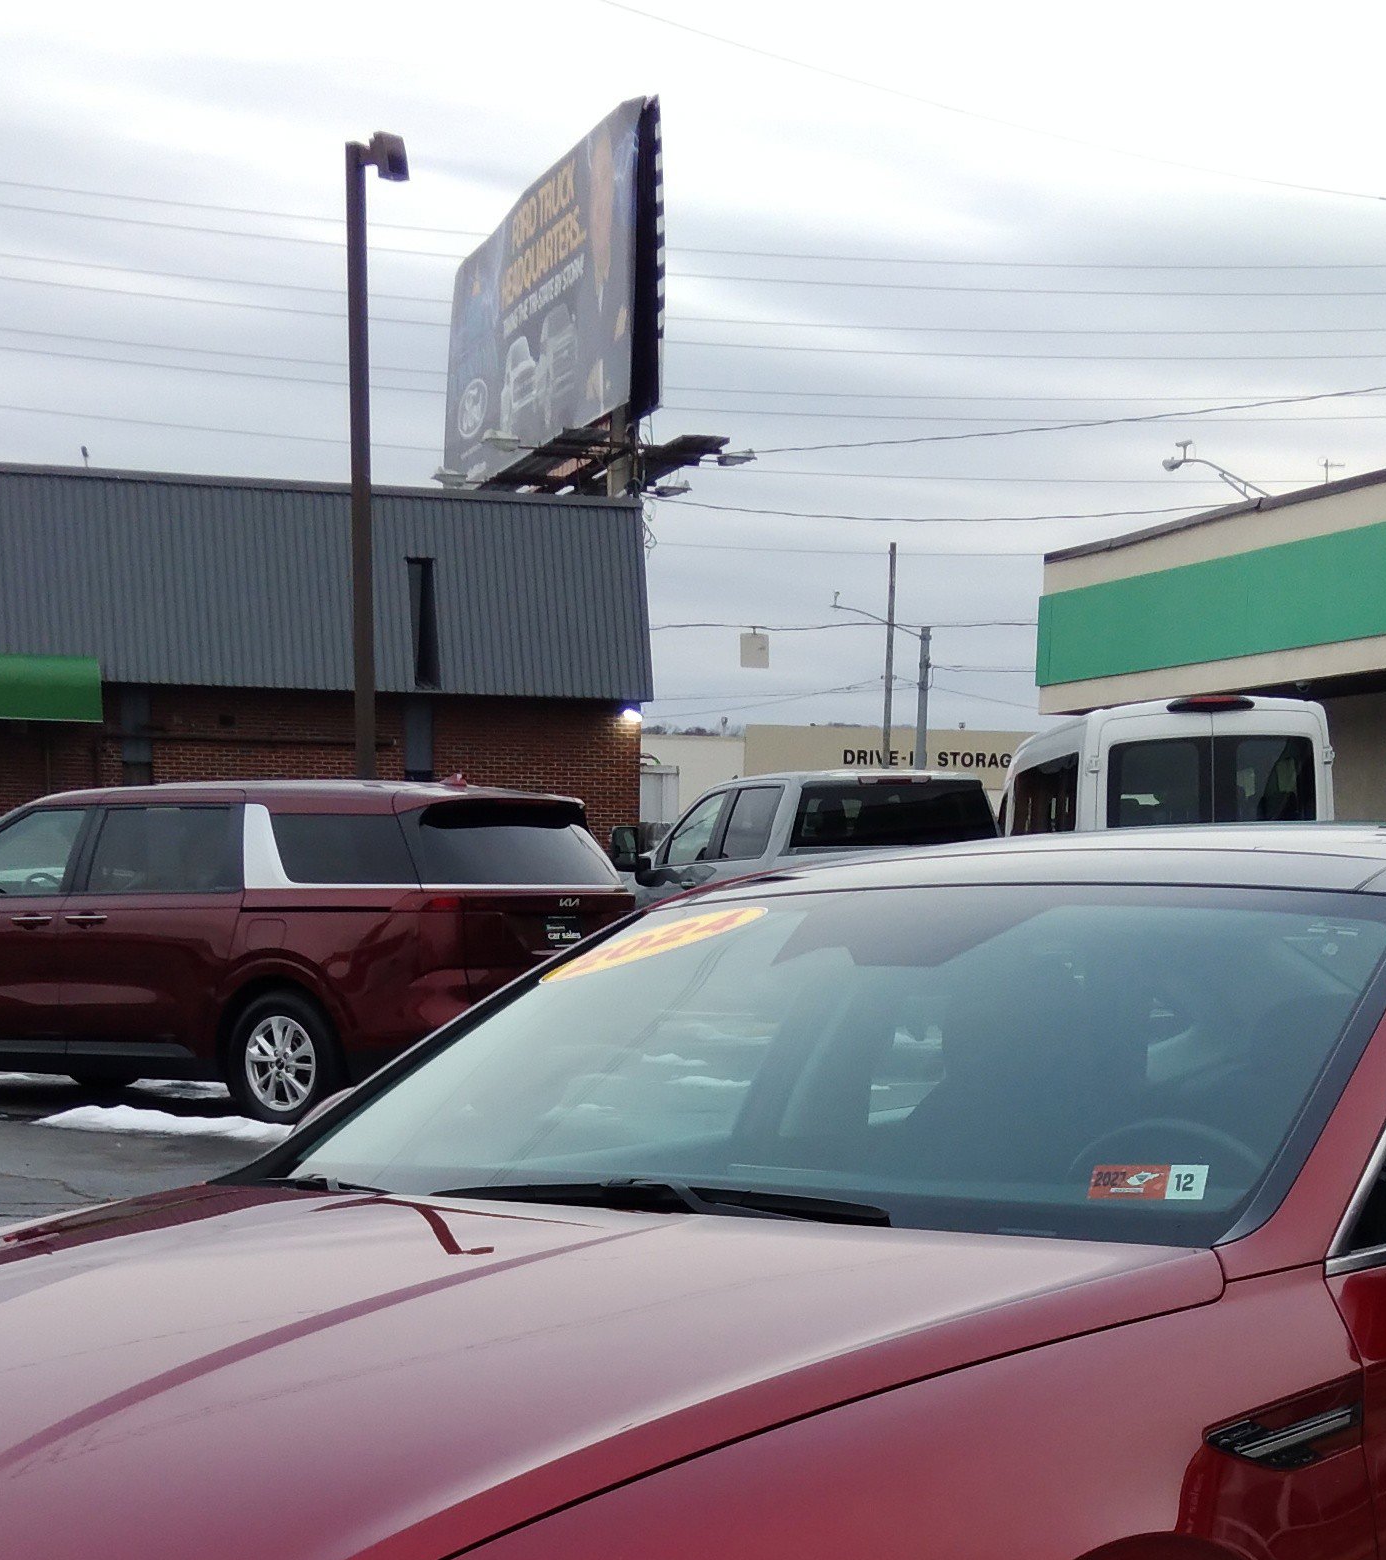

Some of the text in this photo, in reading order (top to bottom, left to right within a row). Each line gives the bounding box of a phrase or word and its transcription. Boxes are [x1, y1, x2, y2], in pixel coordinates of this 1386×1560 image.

[538, 159, 576, 228] TRUCK
[843, 750, 1012, 768] DRIVE-I STORAG
[559, 898, 580, 907] KIA
[562, 909, 747, 977] 2024
[1175, 1173, 1194, 1191] 12
